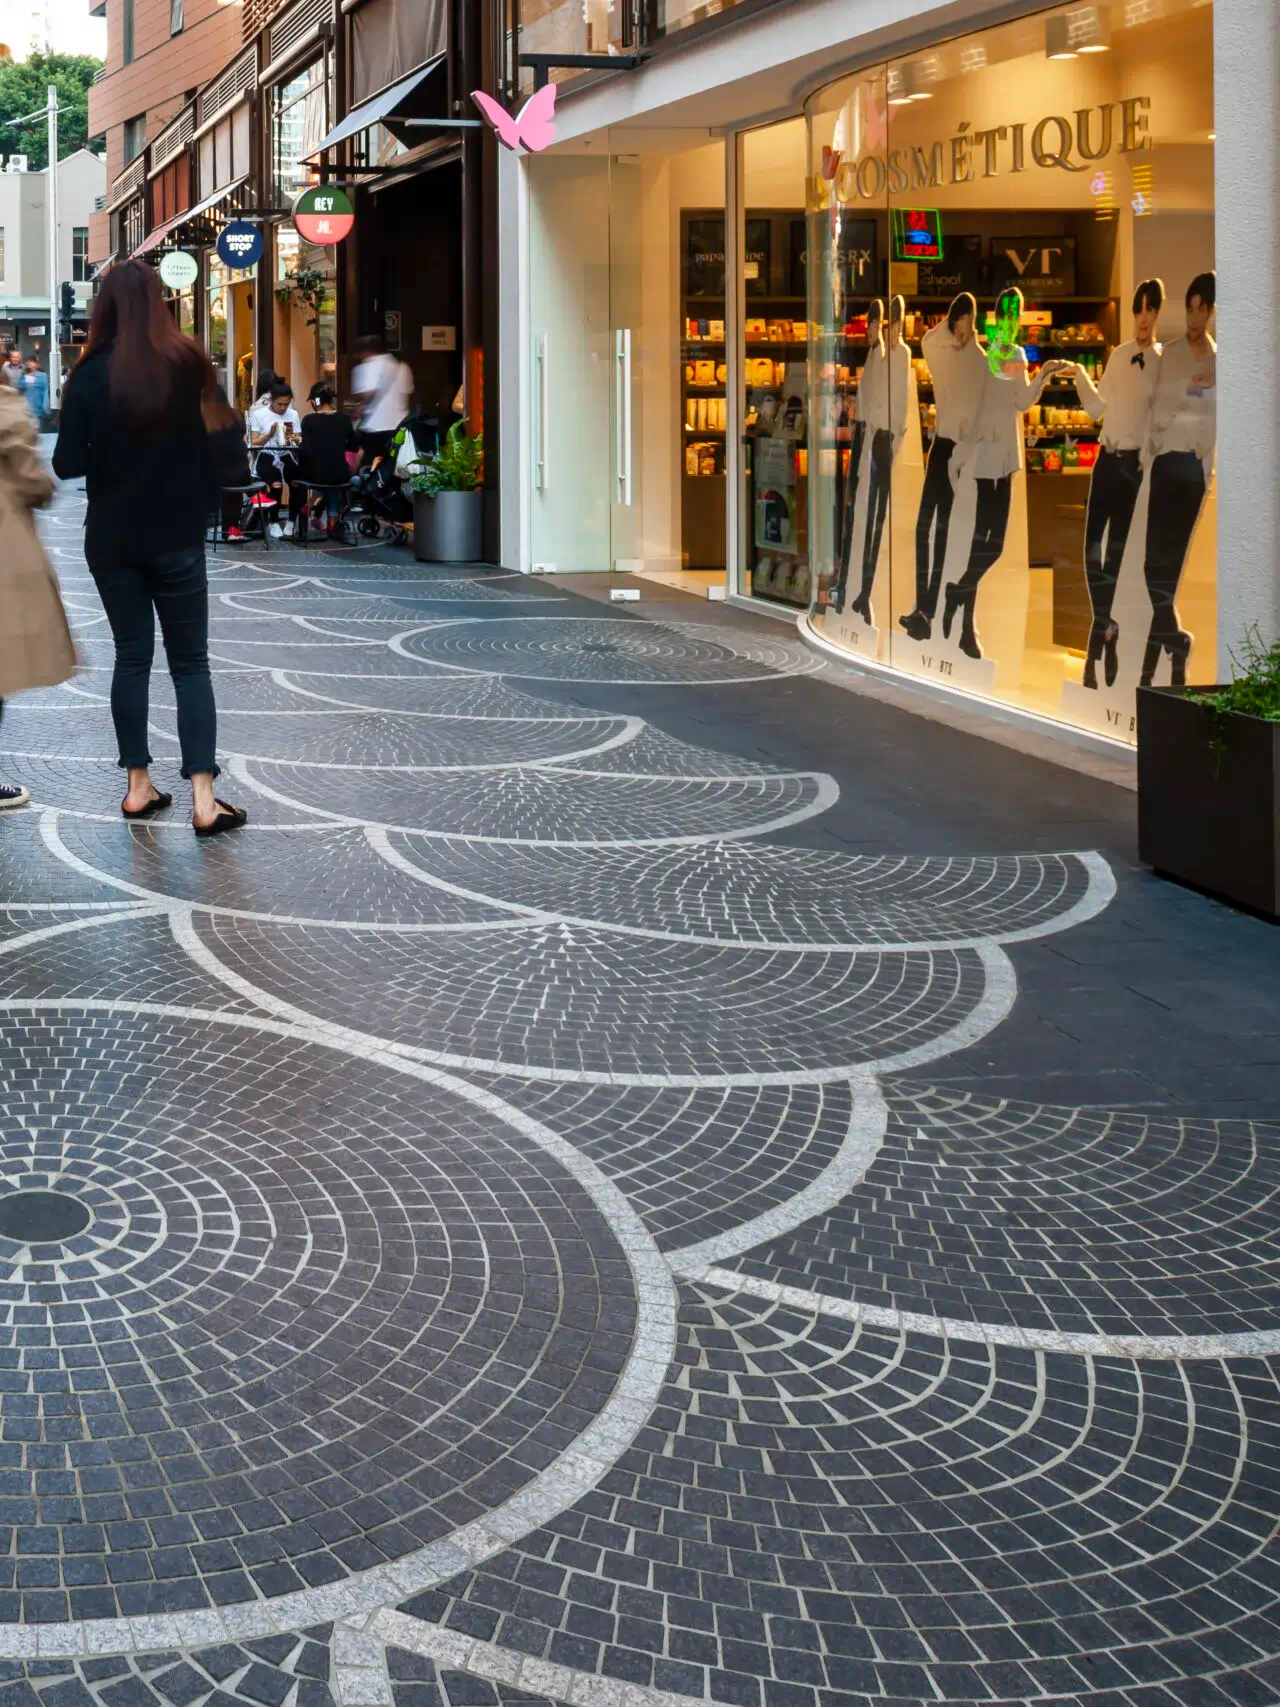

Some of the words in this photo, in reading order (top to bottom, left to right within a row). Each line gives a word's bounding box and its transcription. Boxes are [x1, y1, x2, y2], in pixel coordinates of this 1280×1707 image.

[836, 97, 1153, 203] COSMÉTIQUE
[314, 197, 334, 212] REY
[225, 234, 256, 244] SHORT
[228, 242, 253, 252] STOP
[1005, 248, 1063, 275] VT
[940, 660, 953, 676] BTS
[1106, 708, 1122, 726] VT
